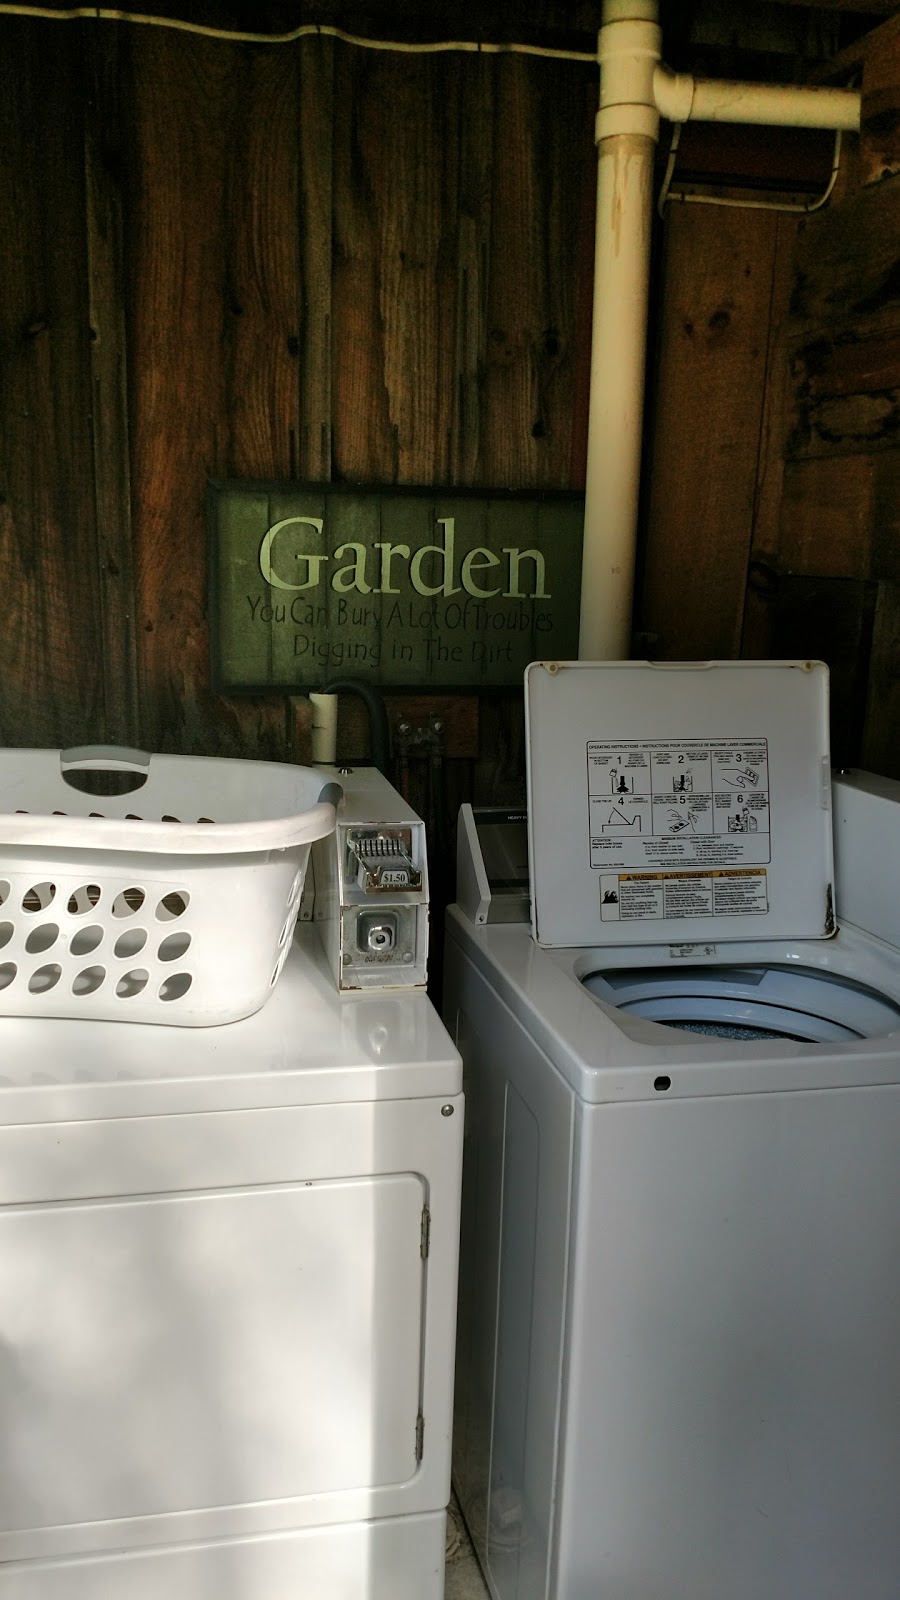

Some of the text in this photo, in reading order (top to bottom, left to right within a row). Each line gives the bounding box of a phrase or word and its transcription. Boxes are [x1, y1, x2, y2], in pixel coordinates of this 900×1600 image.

[259, 516, 552, 599] Garden
[246, 595, 554, 632] You Can Bury A Lot Of Troubles
[294, 635, 512, 668] Digging in The Dirt
[678, 755, 684, 763] 2
[736, 754, 742, 762] 3
[618, 797, 624, 805] 4
[680, 796, 686, 804] 5
[737, 795, 744, 803] 6
[384, 873, 405, 882] $1.50
